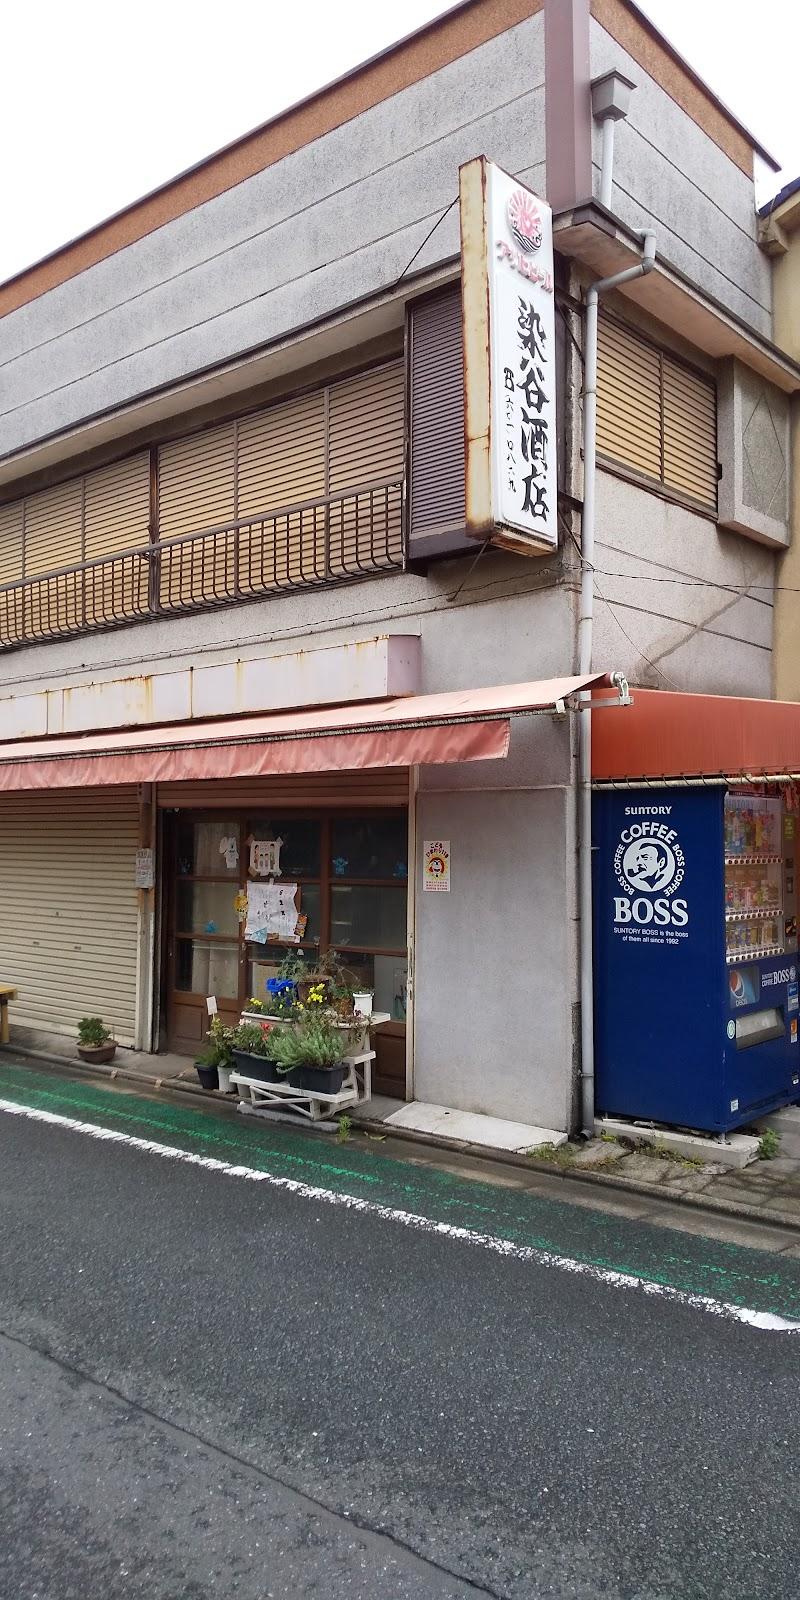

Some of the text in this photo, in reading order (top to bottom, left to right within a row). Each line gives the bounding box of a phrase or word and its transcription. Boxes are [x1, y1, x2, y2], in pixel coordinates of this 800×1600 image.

[517, 296, 550, 522] 染谷酒店
[624, 806, 672, 815] SUNTORY
[620, 821, 678, 844] COFFEE
[614, 843, 634, 895] BOSS COFFEE
[663, 844, 686, 897] BOSS COFFEE
[613, 897, 689, 927] BOSS
[613, 927, 641, 935] SUNTORY
[641, 928, 659, 936] BOSS
[674, 930, 689, 938] boss
[629, 935, 642, 943] them
[773, 968, 790, 985] BOSS
